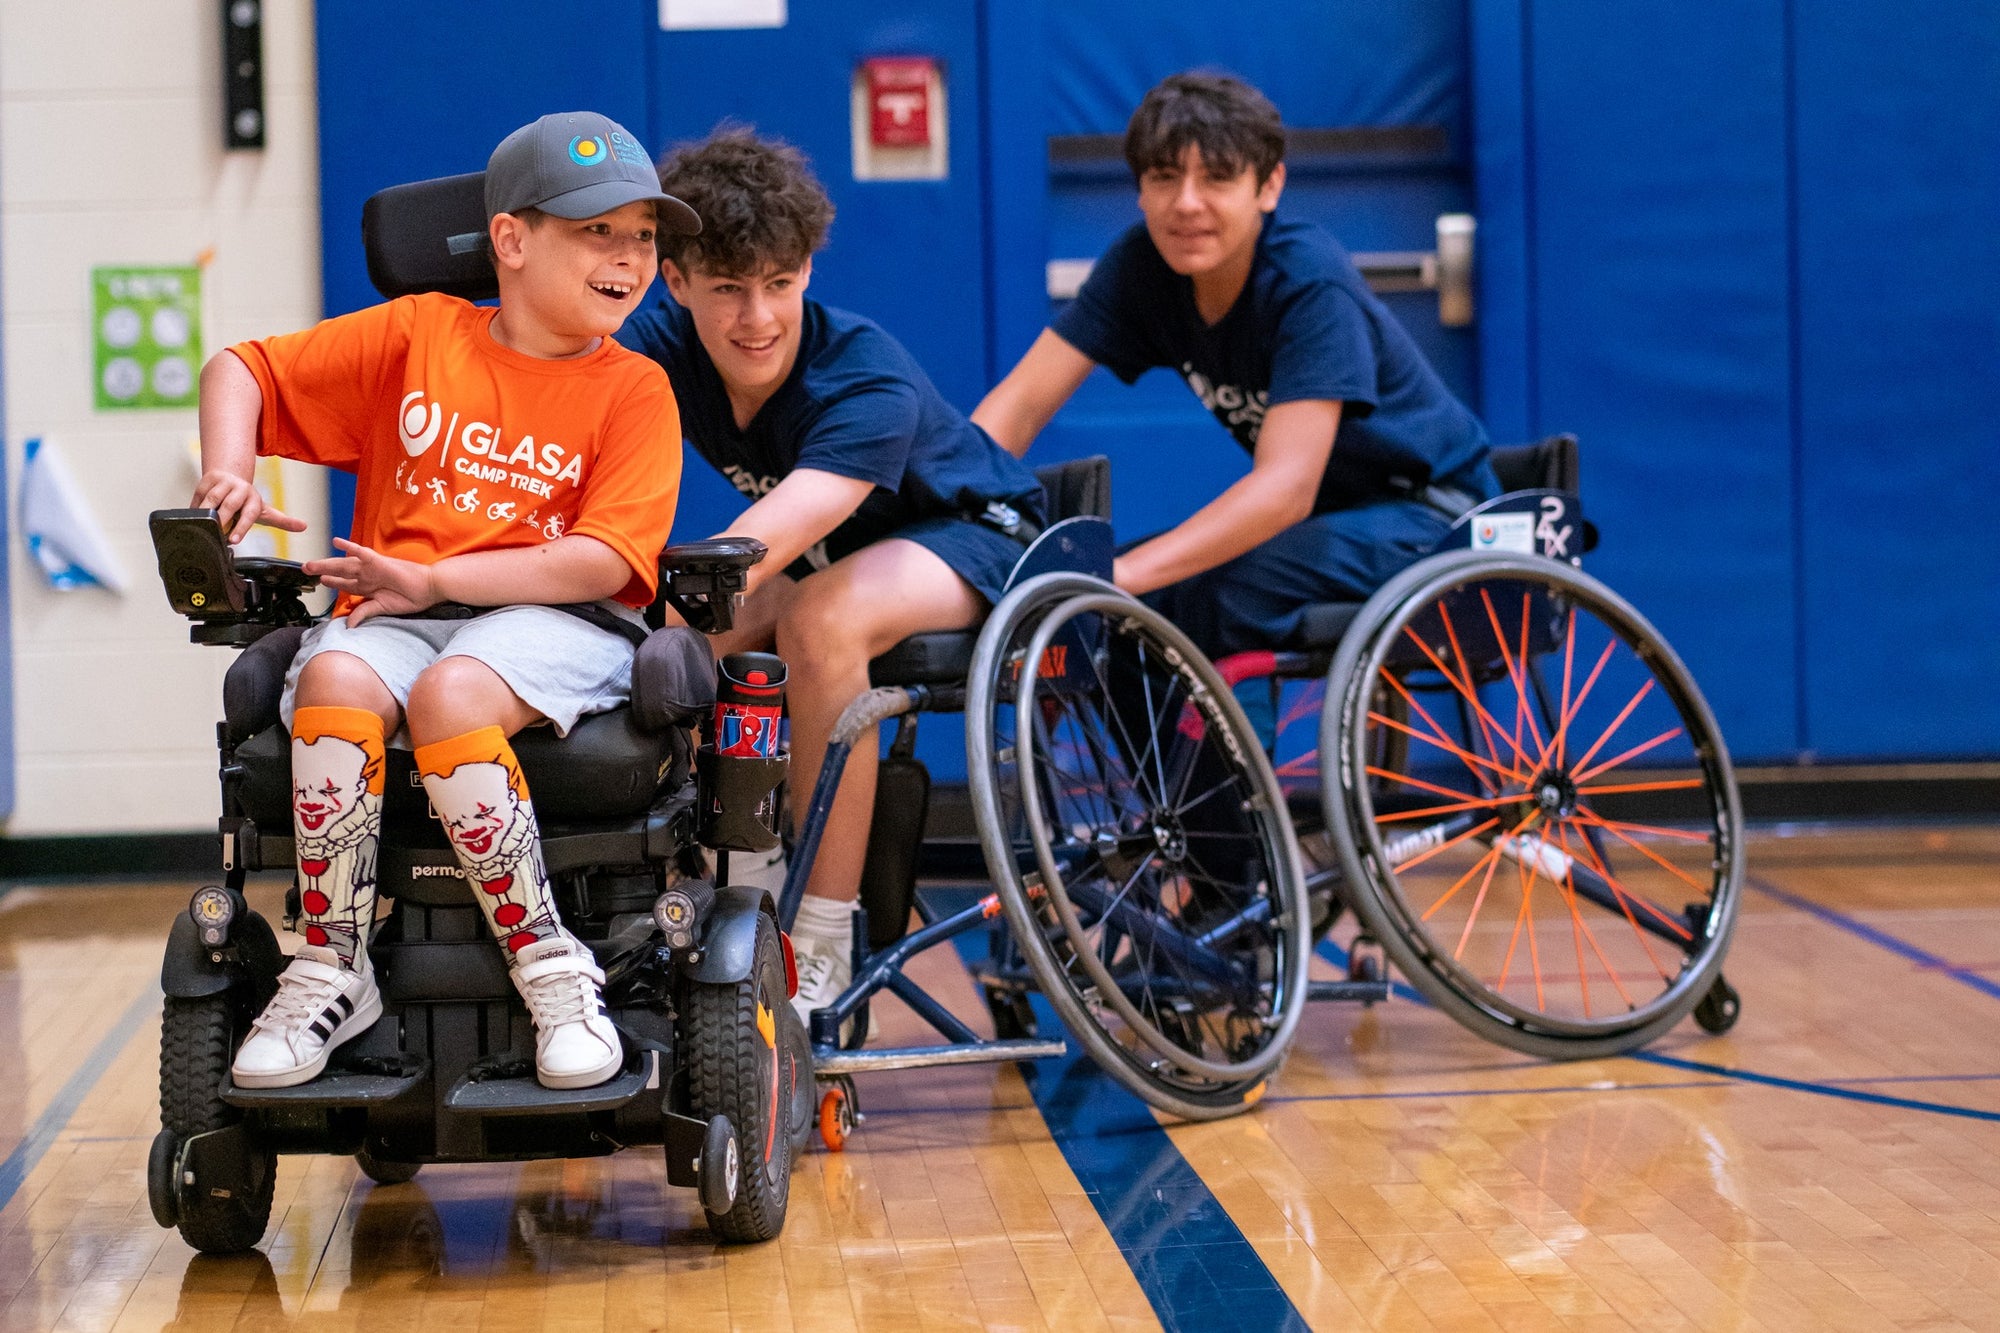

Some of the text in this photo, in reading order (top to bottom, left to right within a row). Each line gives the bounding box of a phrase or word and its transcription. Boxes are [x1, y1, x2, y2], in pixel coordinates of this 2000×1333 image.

[461, 421, 582, 488] GLASA
[454, 457, 555, 500] CAMP TREK
[411, 865, 466, 880] permo
[538, 948, 569, 960] adidas
